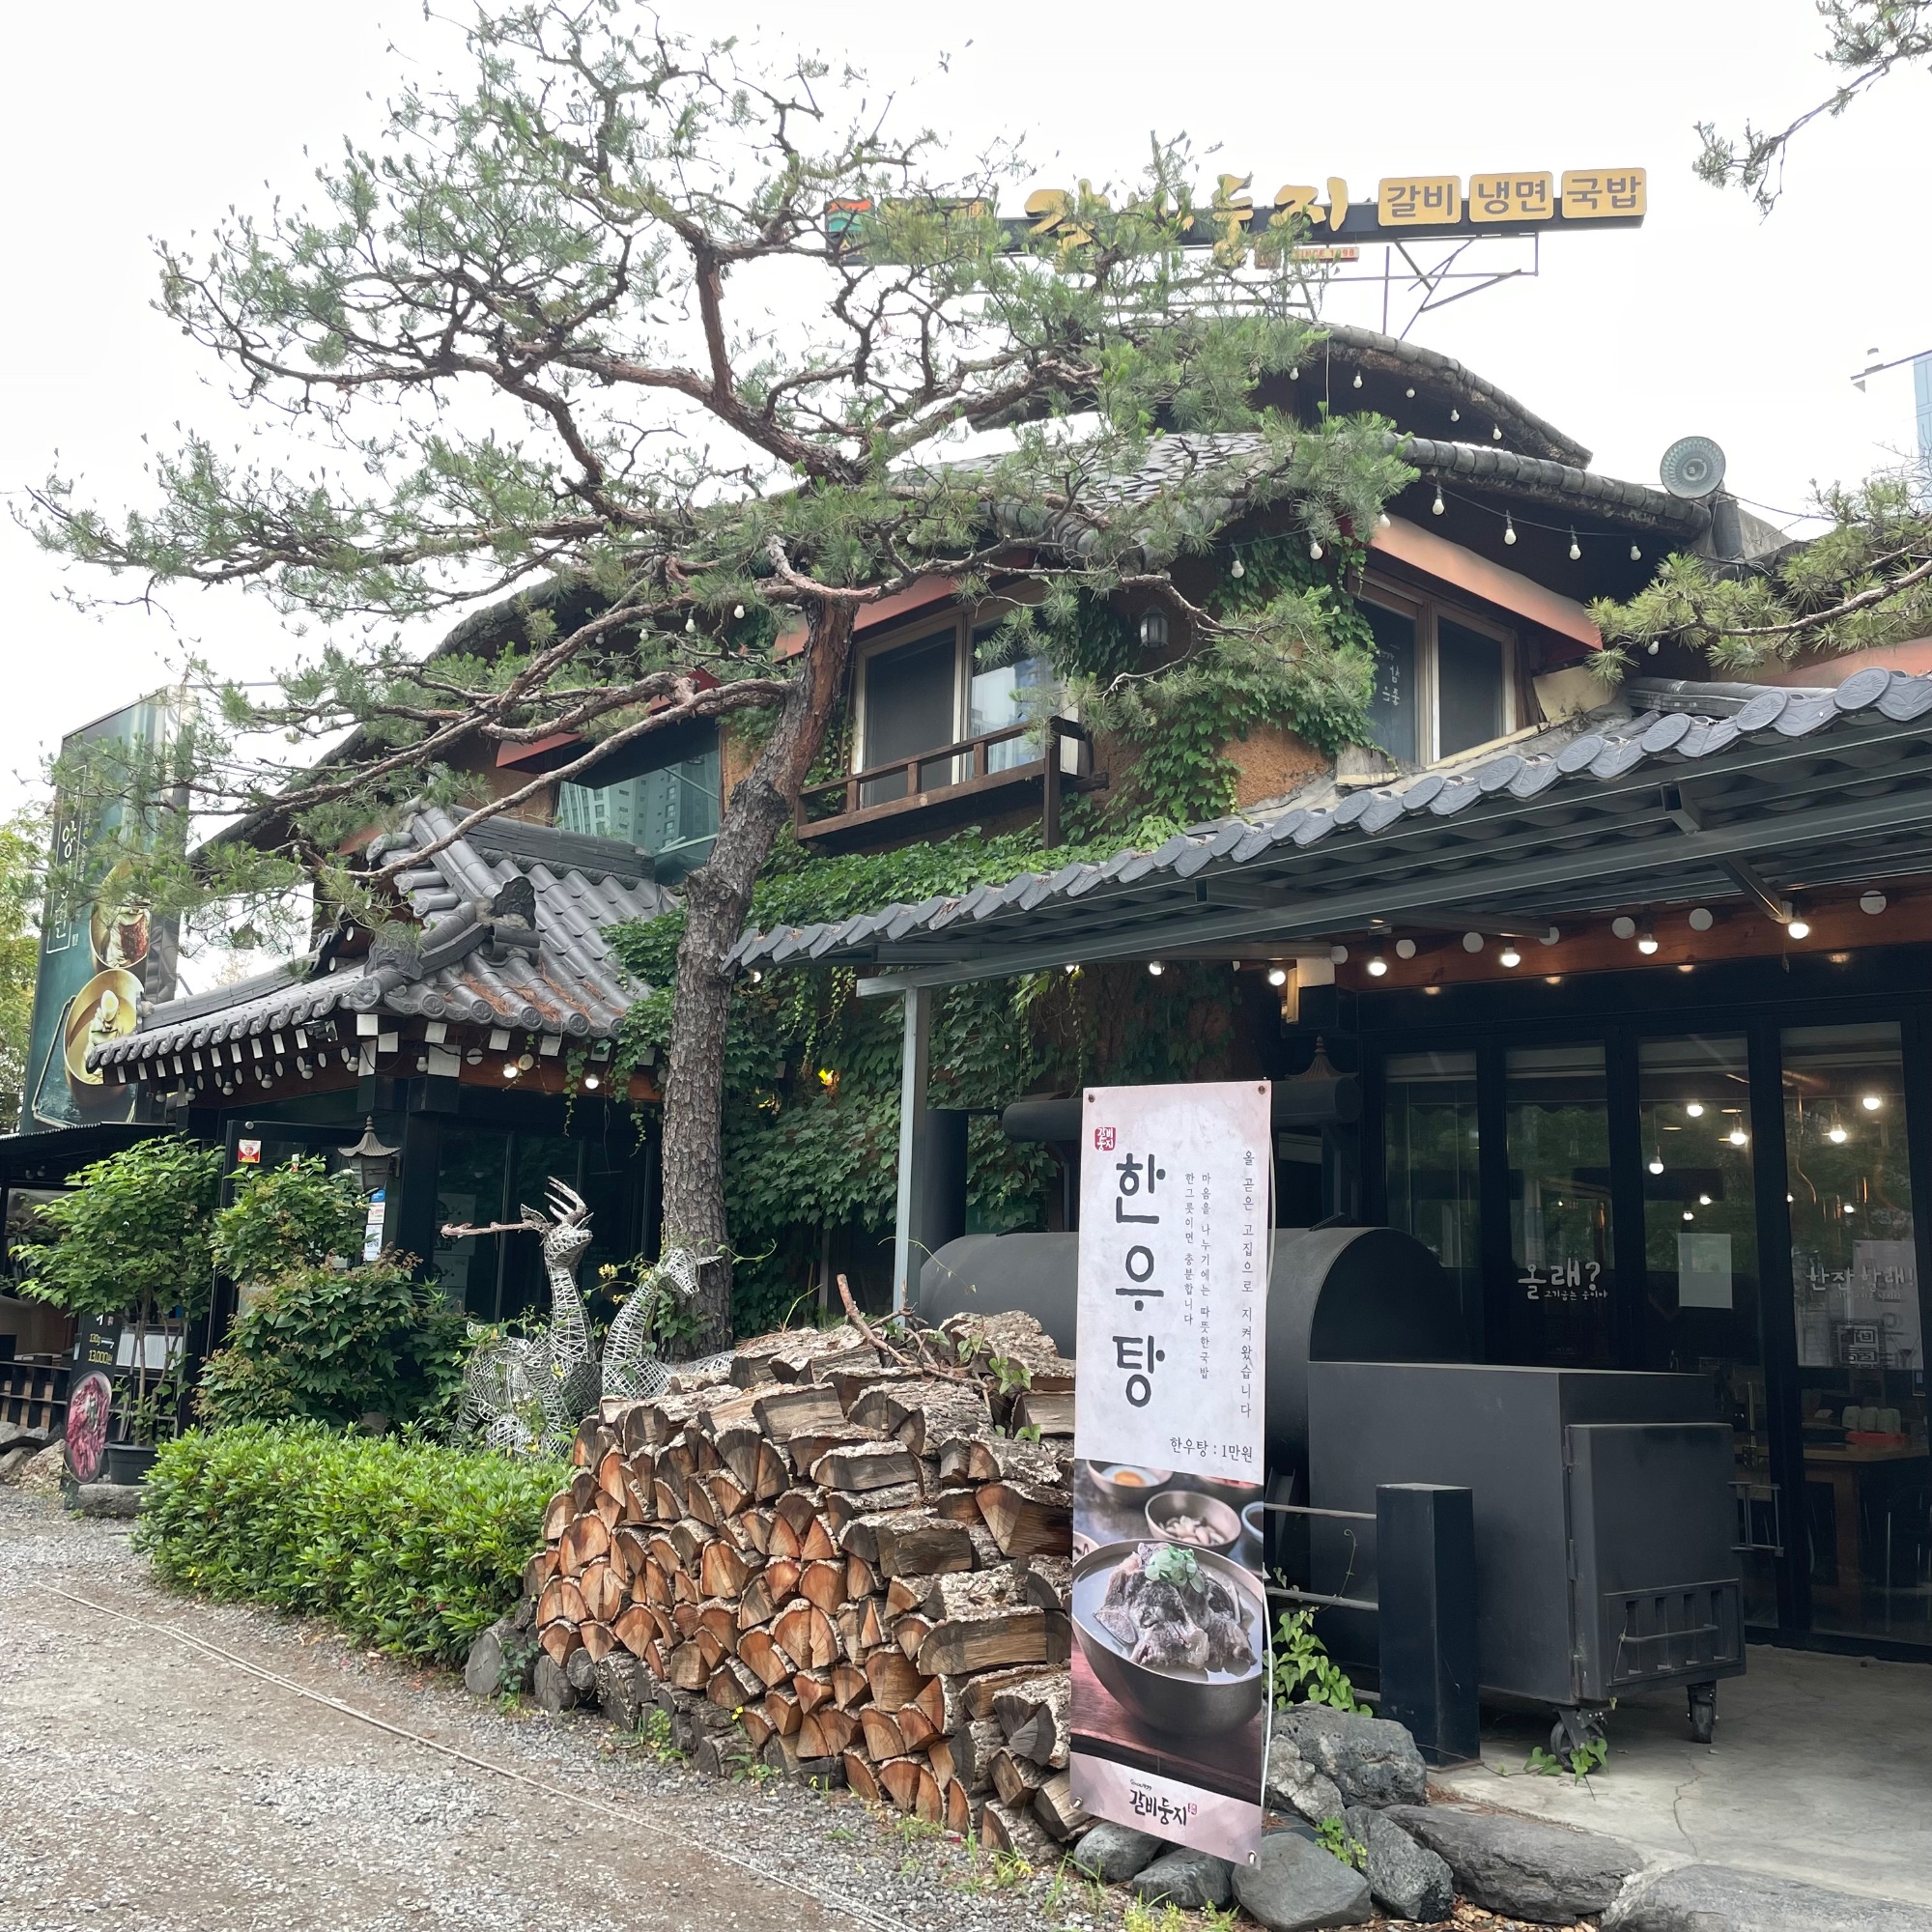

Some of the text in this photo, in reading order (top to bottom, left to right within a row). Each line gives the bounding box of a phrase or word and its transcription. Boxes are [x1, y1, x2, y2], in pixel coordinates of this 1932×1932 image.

[1386, 184, 1453, 218] 갈비
[1478, 179, 1547, 214] 냉면
[1567, 176, 1642, 211] 국밥
[1201, 1172, 1211, 1215] 마음을
[1242, 1178, 1255, 1211] 곧은
[1183, 1172, 1195, 1325] 한그릇이면 충분합니다
[1200, 1223, 1210, 1296] 나누기에는
[1241, 1224, 1254, 1293] 고집으로
[1112, 1152, 1166, 1407] 한우탕
[1518, 1257, 1601, 1300] 올래?
[1240, 1306, 1254, 1418] 지켜왔습니다
[1170, 1436, 1208, 1458] 한우탕
[1221, 1444, 1253, 1463] 1만원
[1129, 1789, 1187, 1826] 갈비둥지
